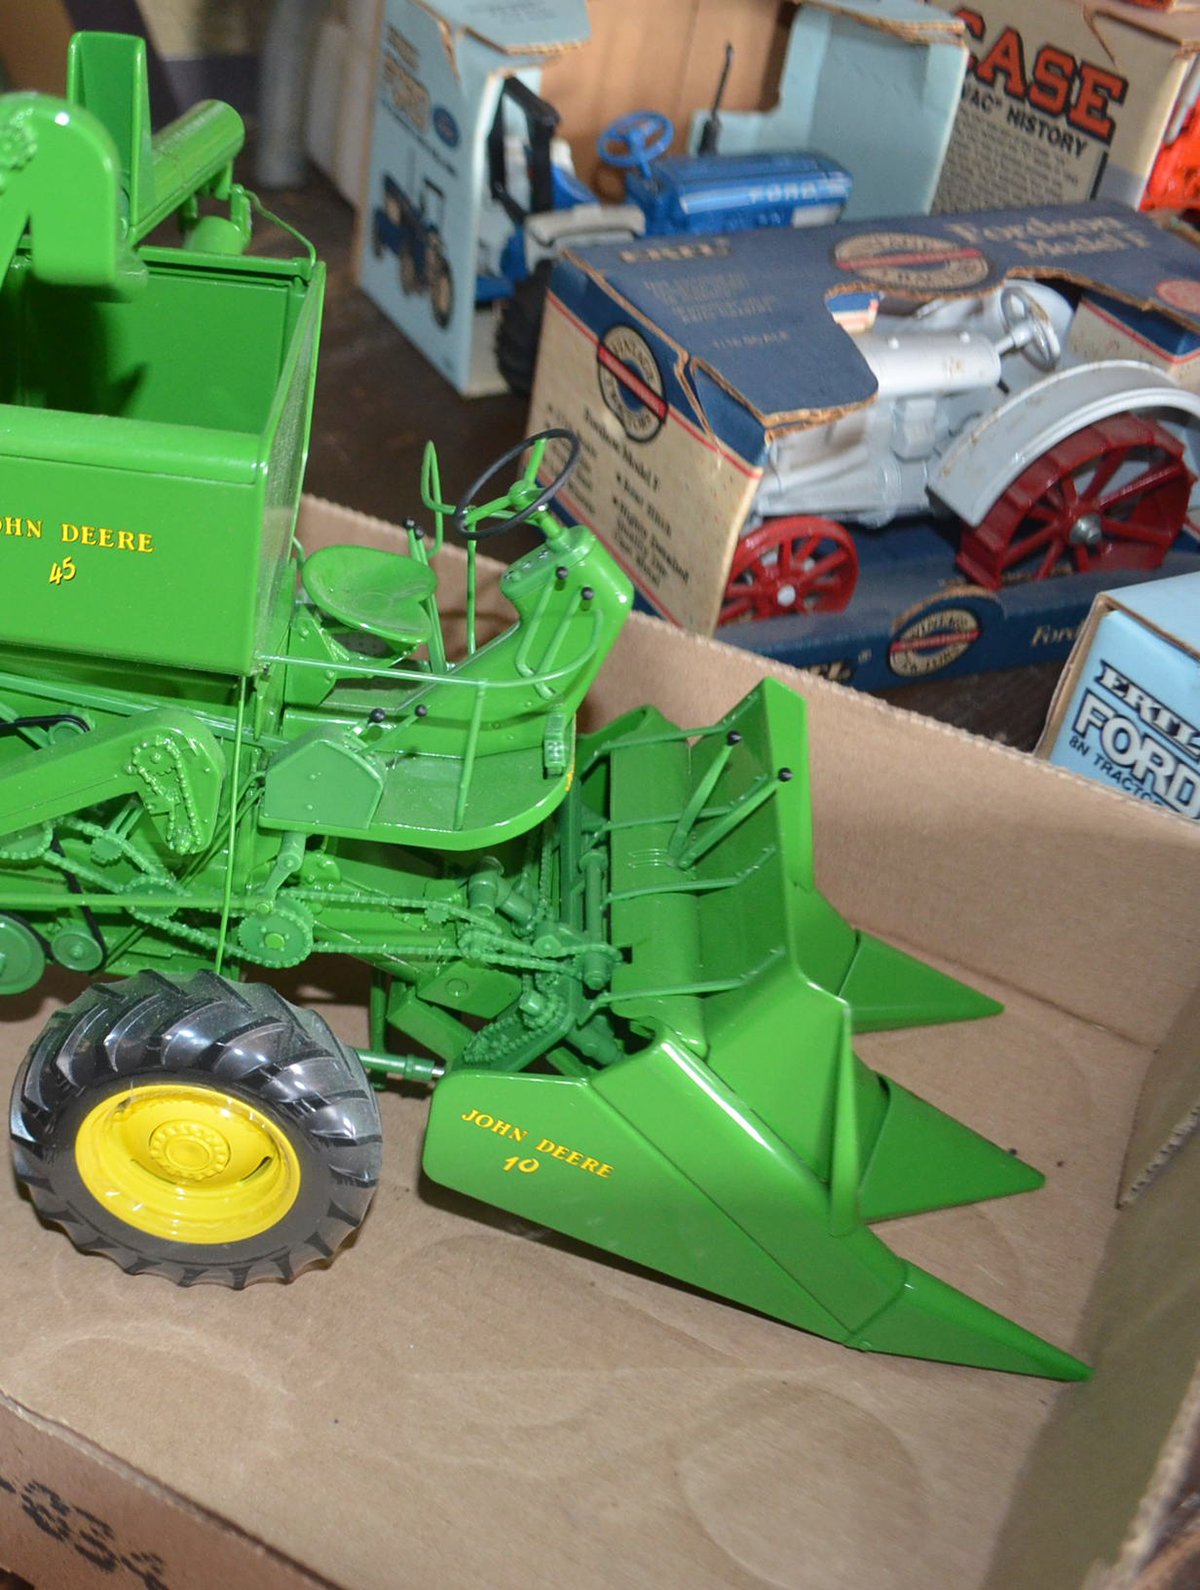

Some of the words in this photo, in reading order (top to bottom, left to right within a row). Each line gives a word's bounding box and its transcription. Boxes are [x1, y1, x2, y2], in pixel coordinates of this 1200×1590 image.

[61, 522, 154, 553] DEERE
[49, 556, 77, 585] 45
[1072, 687, 1200, 820] FORD
[1093, 751, 1164, 806] TRACTO
[461, 1109, 528, 1142] JOHN
[535, 1138, 615, 1180] DEERE
[503, 1156, 540, 1174] 10
